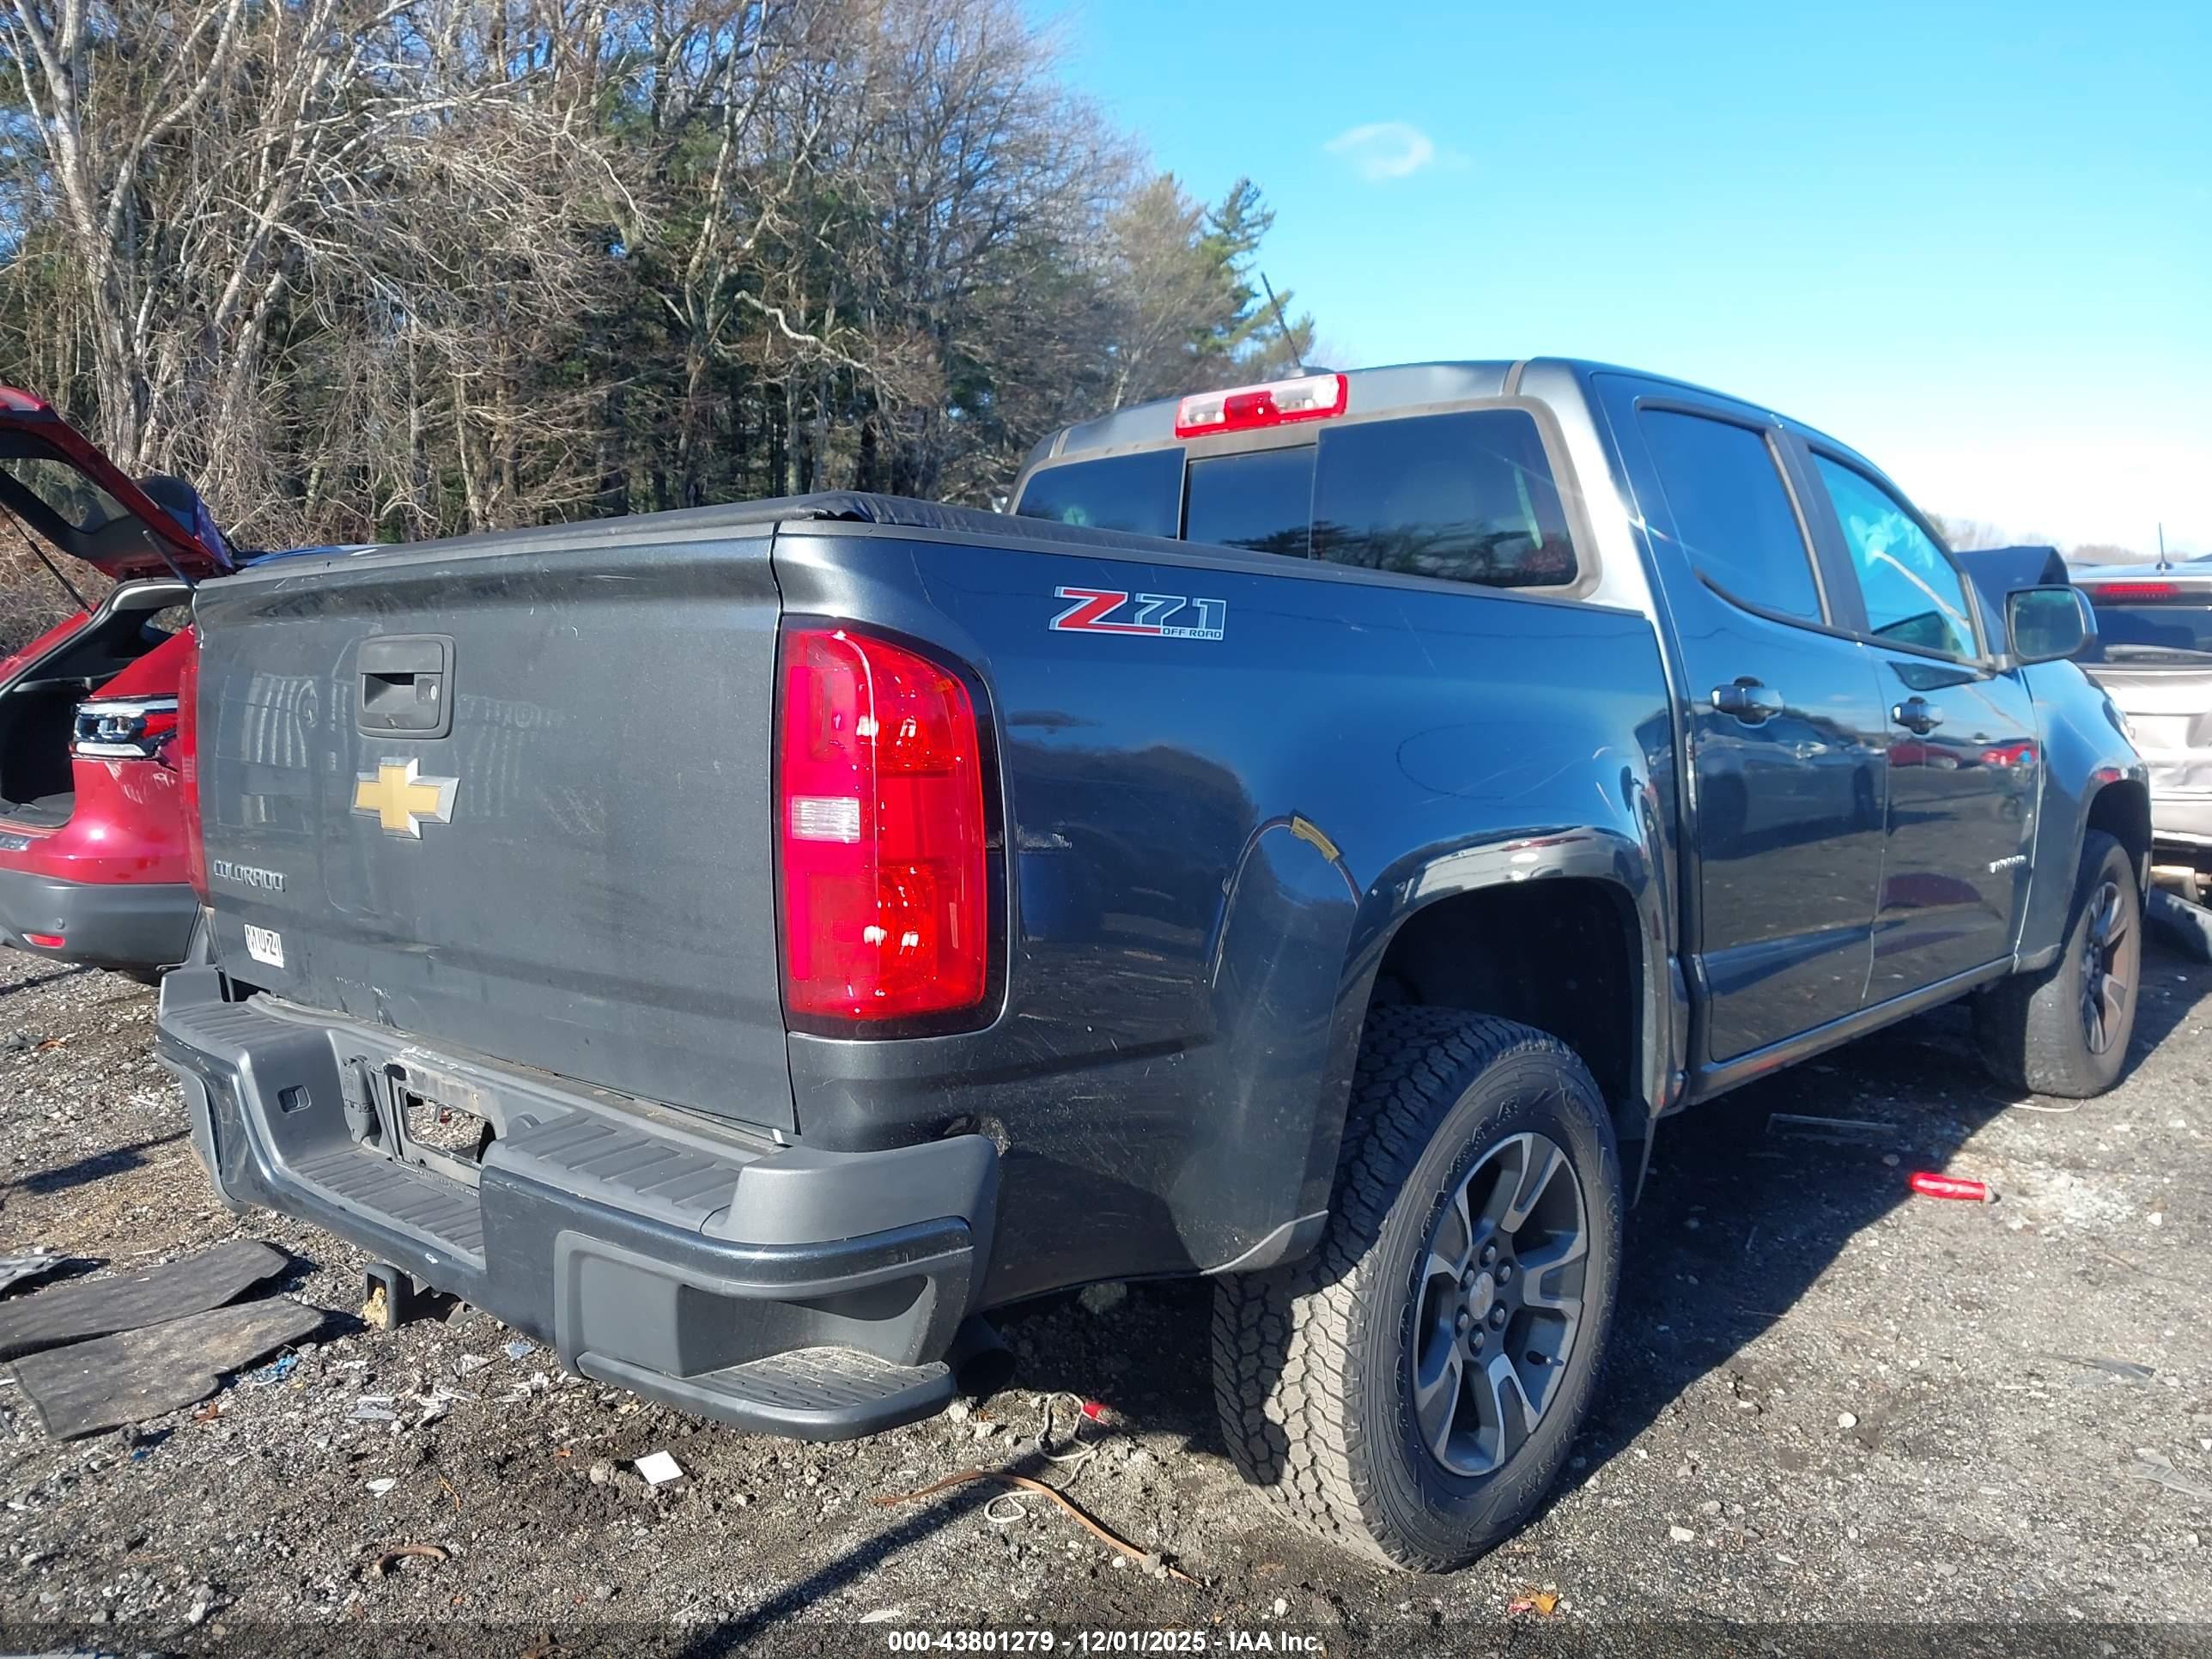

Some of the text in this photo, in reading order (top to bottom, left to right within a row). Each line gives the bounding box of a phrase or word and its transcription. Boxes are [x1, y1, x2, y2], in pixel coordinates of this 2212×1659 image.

[1048, 586, 1226, 637] Z71
[1163, 628, 1222, 639] OFF ROAD
[215, 860, 286, 891] COLORADO
